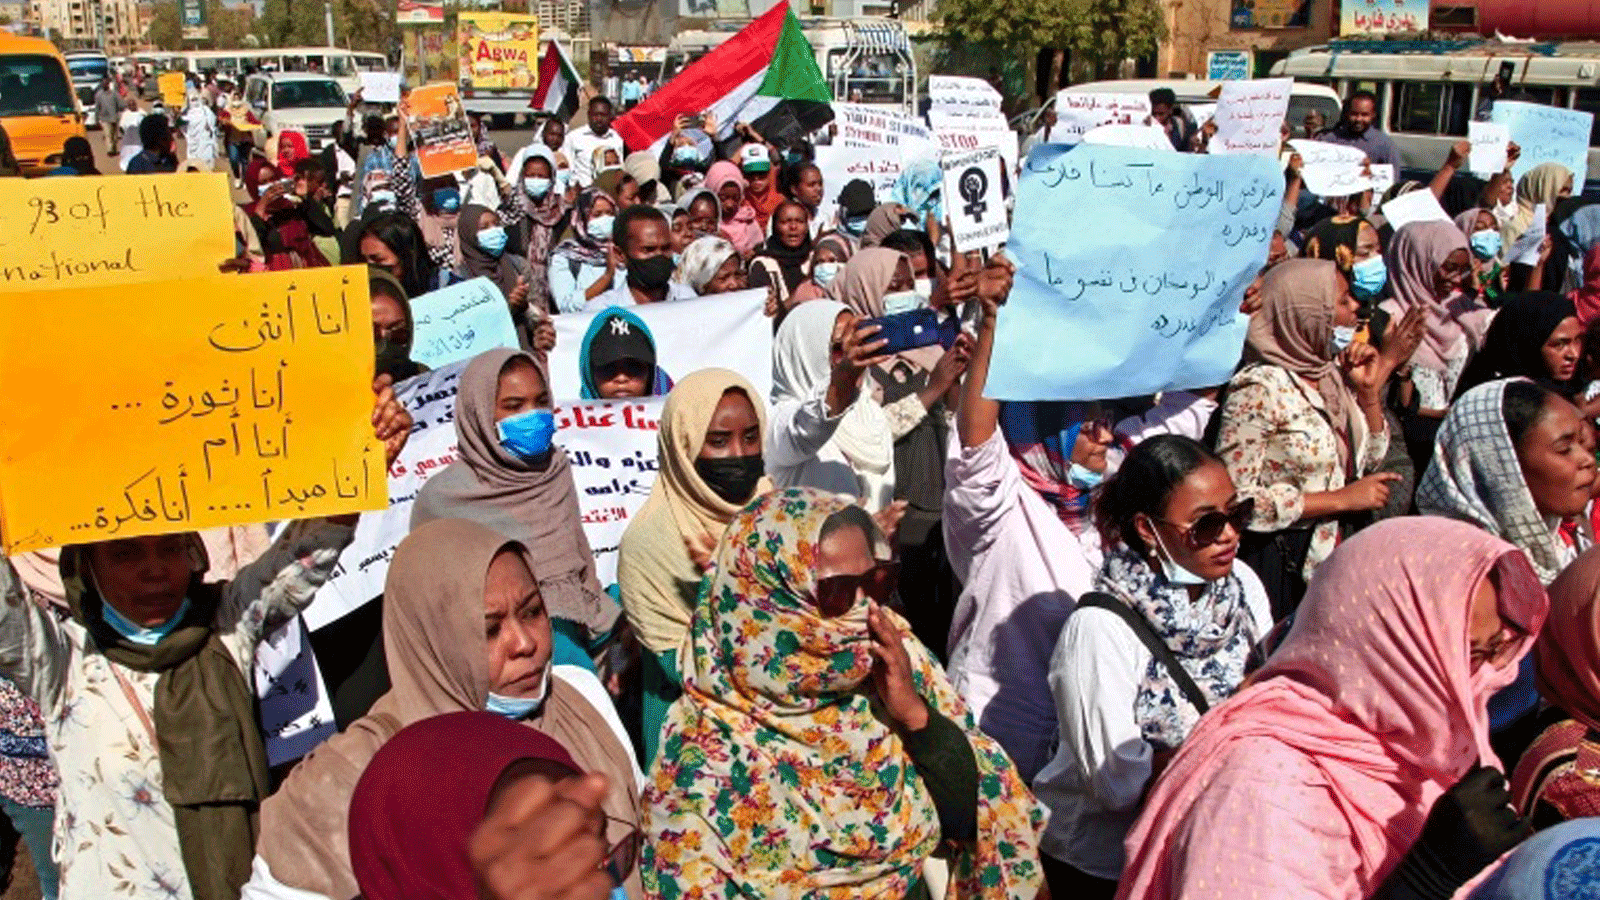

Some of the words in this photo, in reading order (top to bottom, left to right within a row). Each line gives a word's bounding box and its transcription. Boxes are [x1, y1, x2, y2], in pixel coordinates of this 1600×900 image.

[476, 40, 528, 62] ABWA
[69, 186, 110, 230] of
[135, 185, 194, 218] the
[312, 275, 350, 335] أنا
[610, 316, 631, 337] NY
[251, 359, 288, 413] أنا
[203, 408, 241, 482] أم
[253, 411, 293, 459] أنا
[155, 462, 191, 523] أنا
[332, 441, 371, 500] أنا
